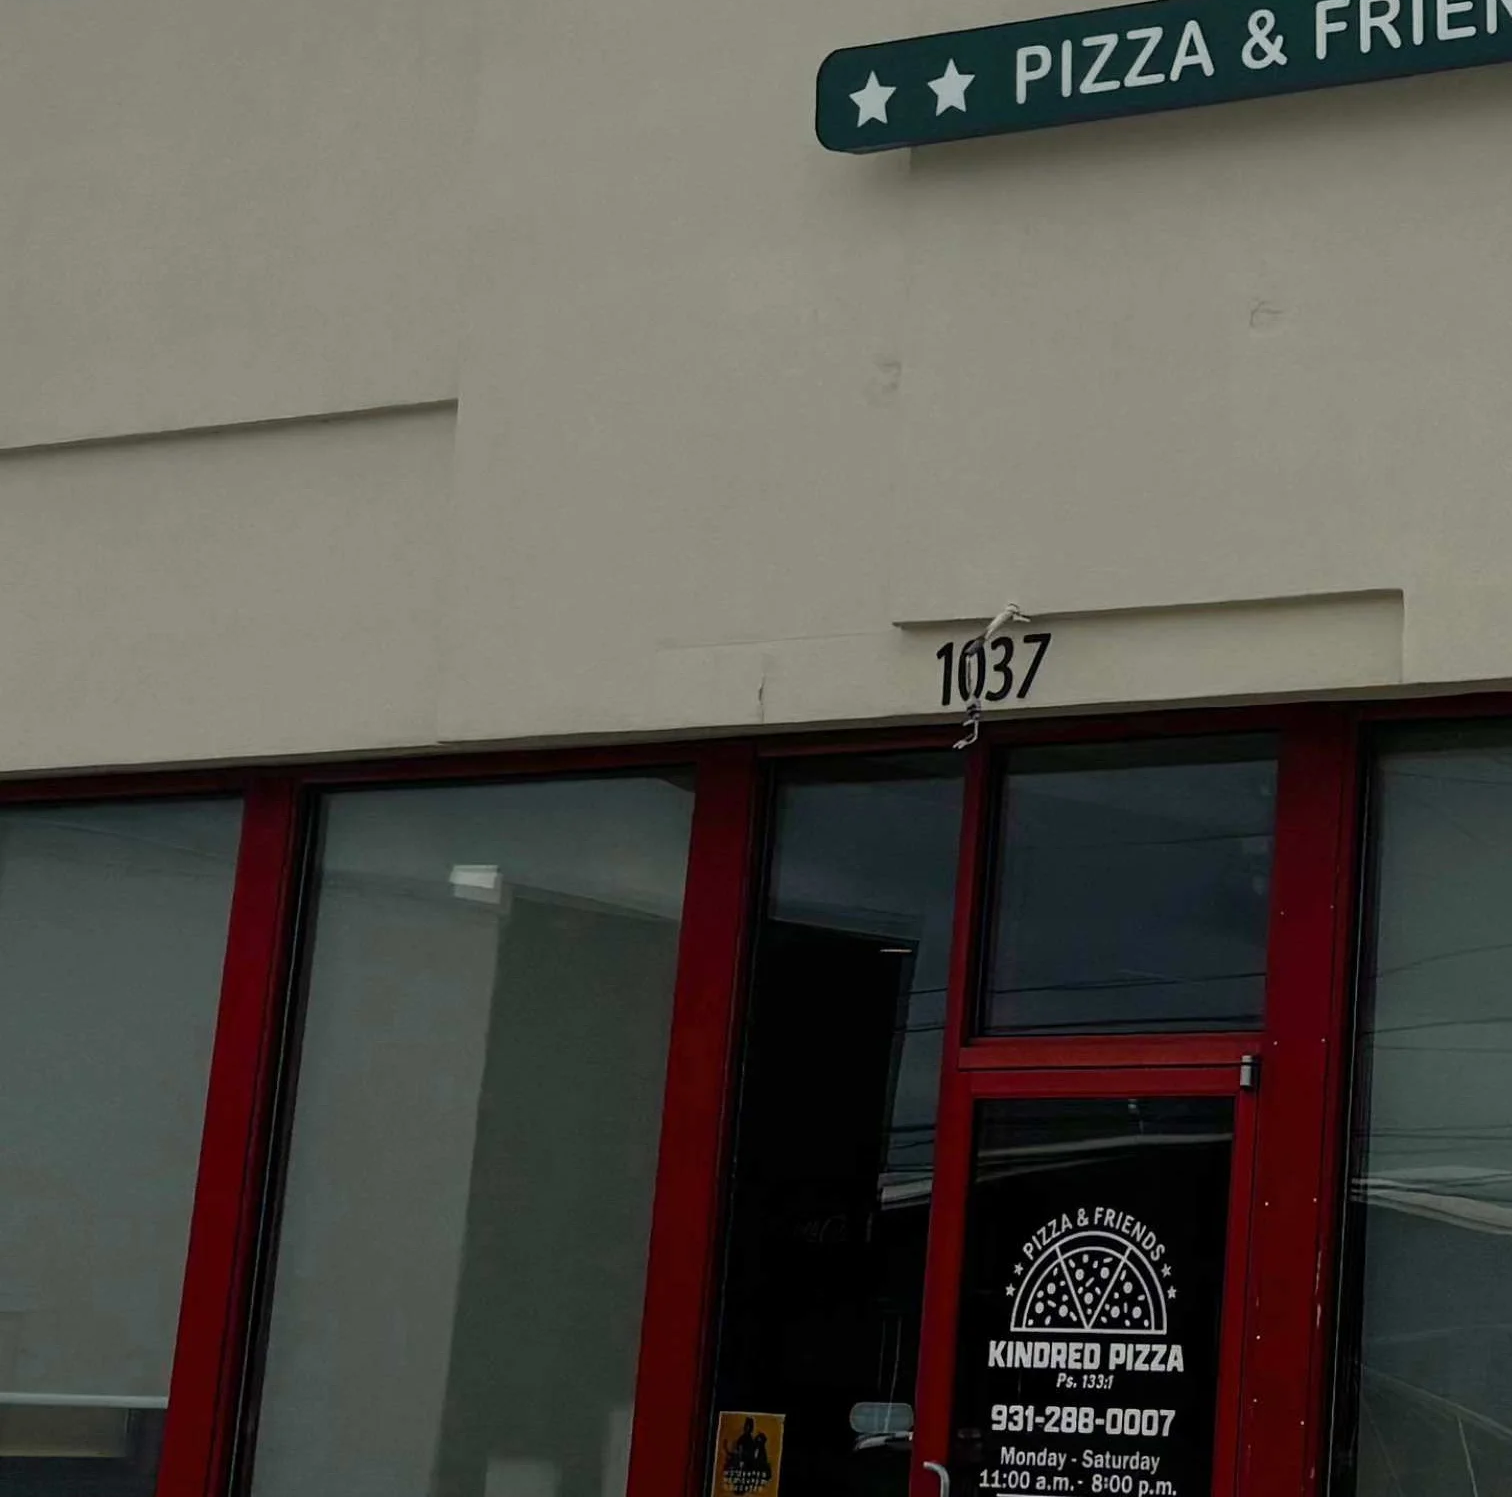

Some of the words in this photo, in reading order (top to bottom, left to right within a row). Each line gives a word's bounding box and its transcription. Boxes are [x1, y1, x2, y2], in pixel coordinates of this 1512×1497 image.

[1016, 20, 1215, 105] PIZZA
[1241, 9, 1288, 69] &
[936, 632, 1052, 706] 1037
[1022, 1213, 1073, 1261] PIZZA
[1076, 1207, 1089, 1227] &
[1093, 1206, 1166, 1262] FRIENDS
[987, 1340, 1101, 1370] KINDRED
[1108, 1342, 1185, 1373] PIZZA
[1055, 1372, 1077, 1389] Ps.
[1082, 1373, 1115, 1390] 133:1
[991, 1404, 1176, 1437] 931-288-0007
[1000, 1446, 1067, 1471] Monday
[1081, 1449, 1161, 1475] Saturday
[979, 1469, 1031, 1490] 11:00
[1091, 1473, 1133, 1494] 8:00
[1138, 1479, 1177, 1497] p.m.
